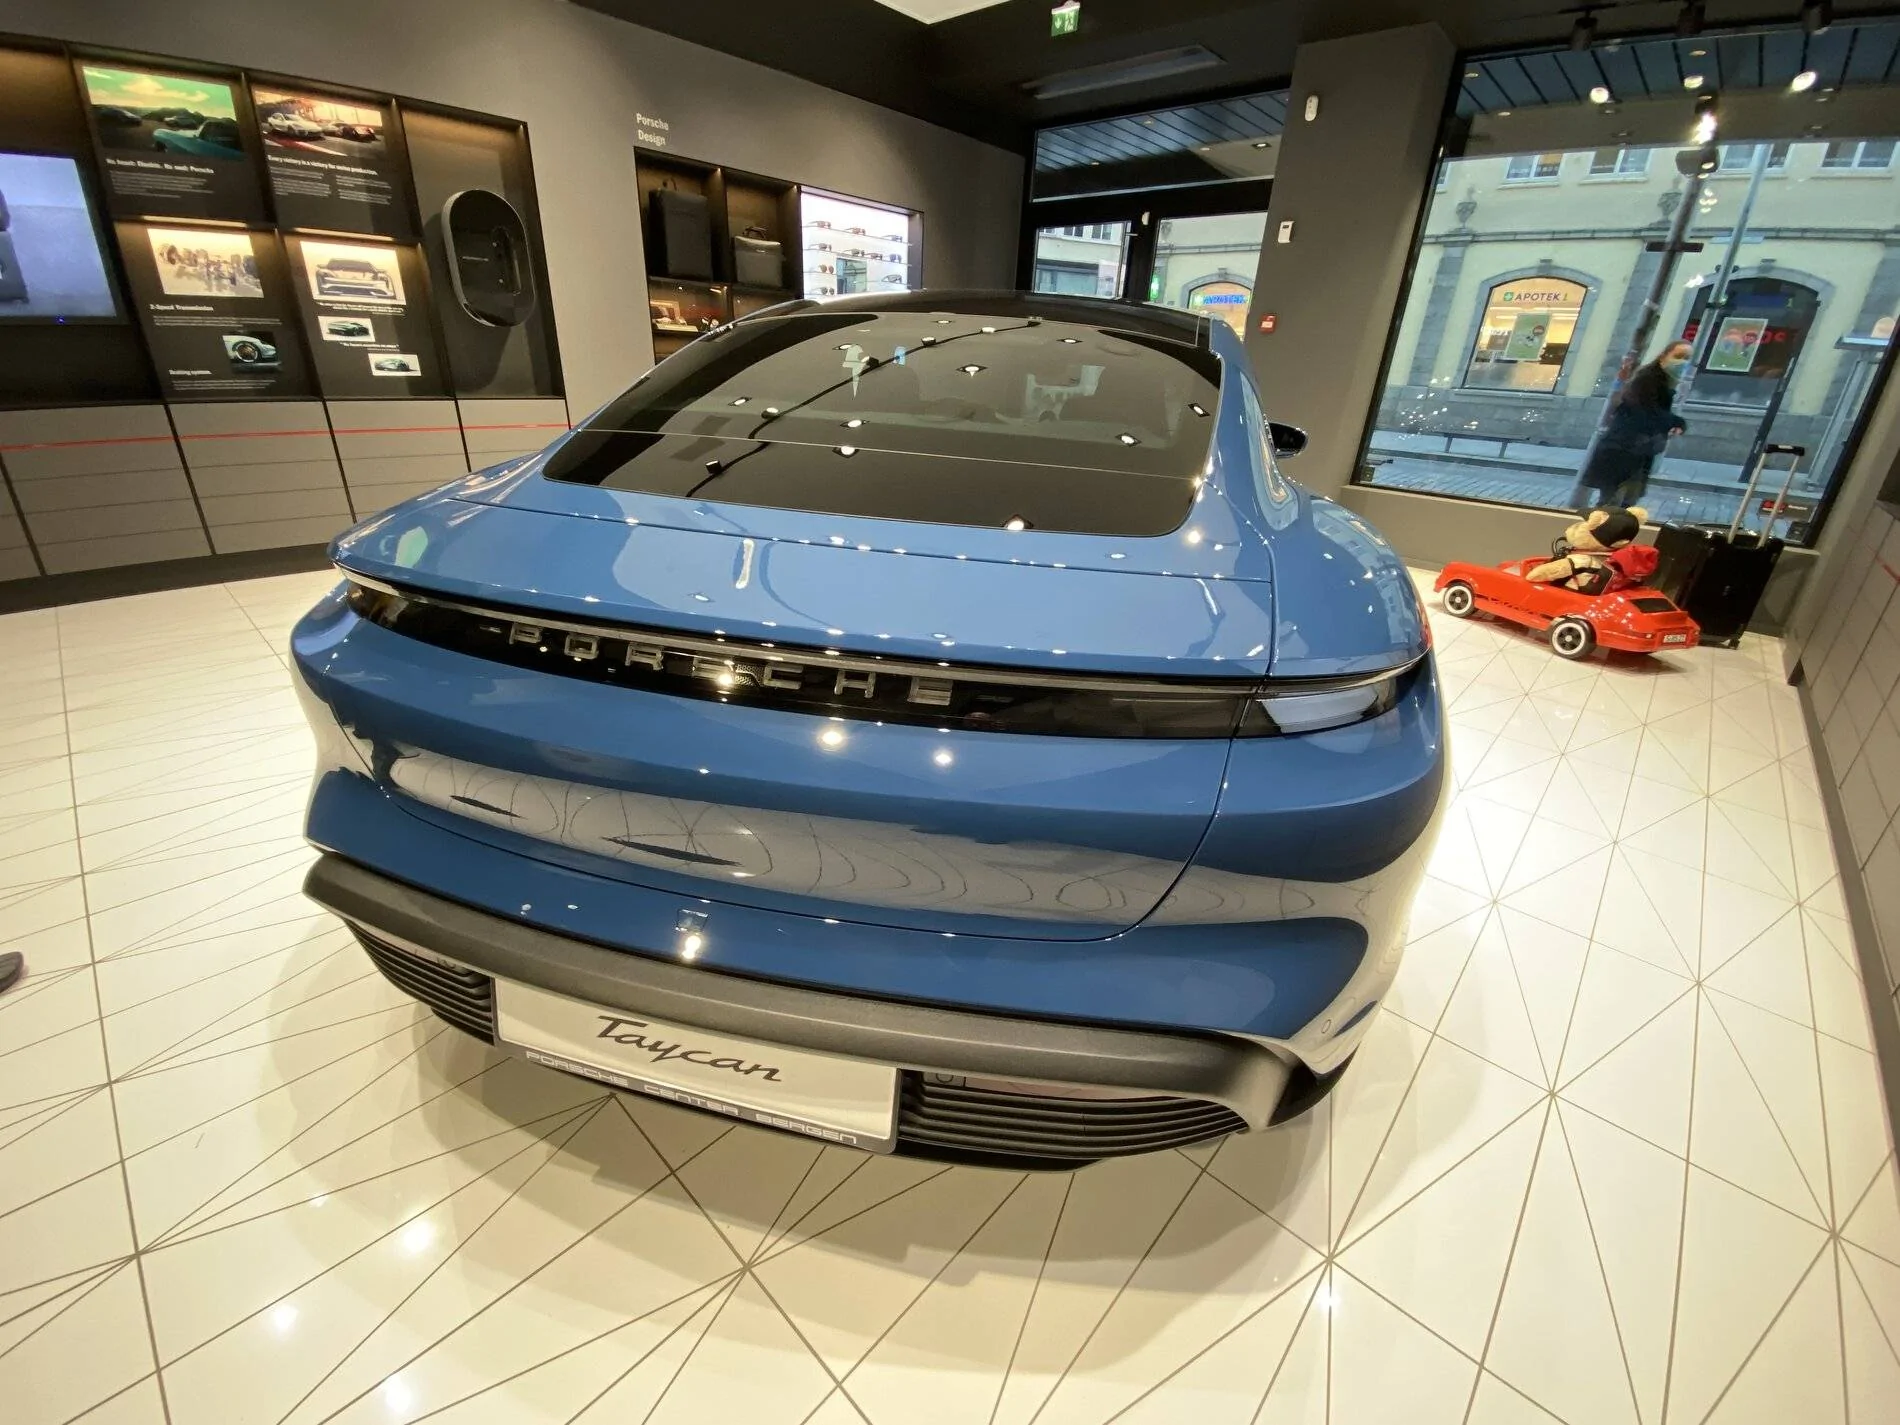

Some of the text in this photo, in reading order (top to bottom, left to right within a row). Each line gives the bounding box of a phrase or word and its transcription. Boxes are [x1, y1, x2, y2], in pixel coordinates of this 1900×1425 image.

[636, 112, 669, 131] Porsche
[638, 129, 666, 146] Design
[1514, 292, 1560, 301] APOTEK
[508, 620, 954, 706] PORSCHE
[596, 1015, 782, 1082] Taycan
[525, 1050, 858, 1145] PORSCHE CENTER BERGEN
